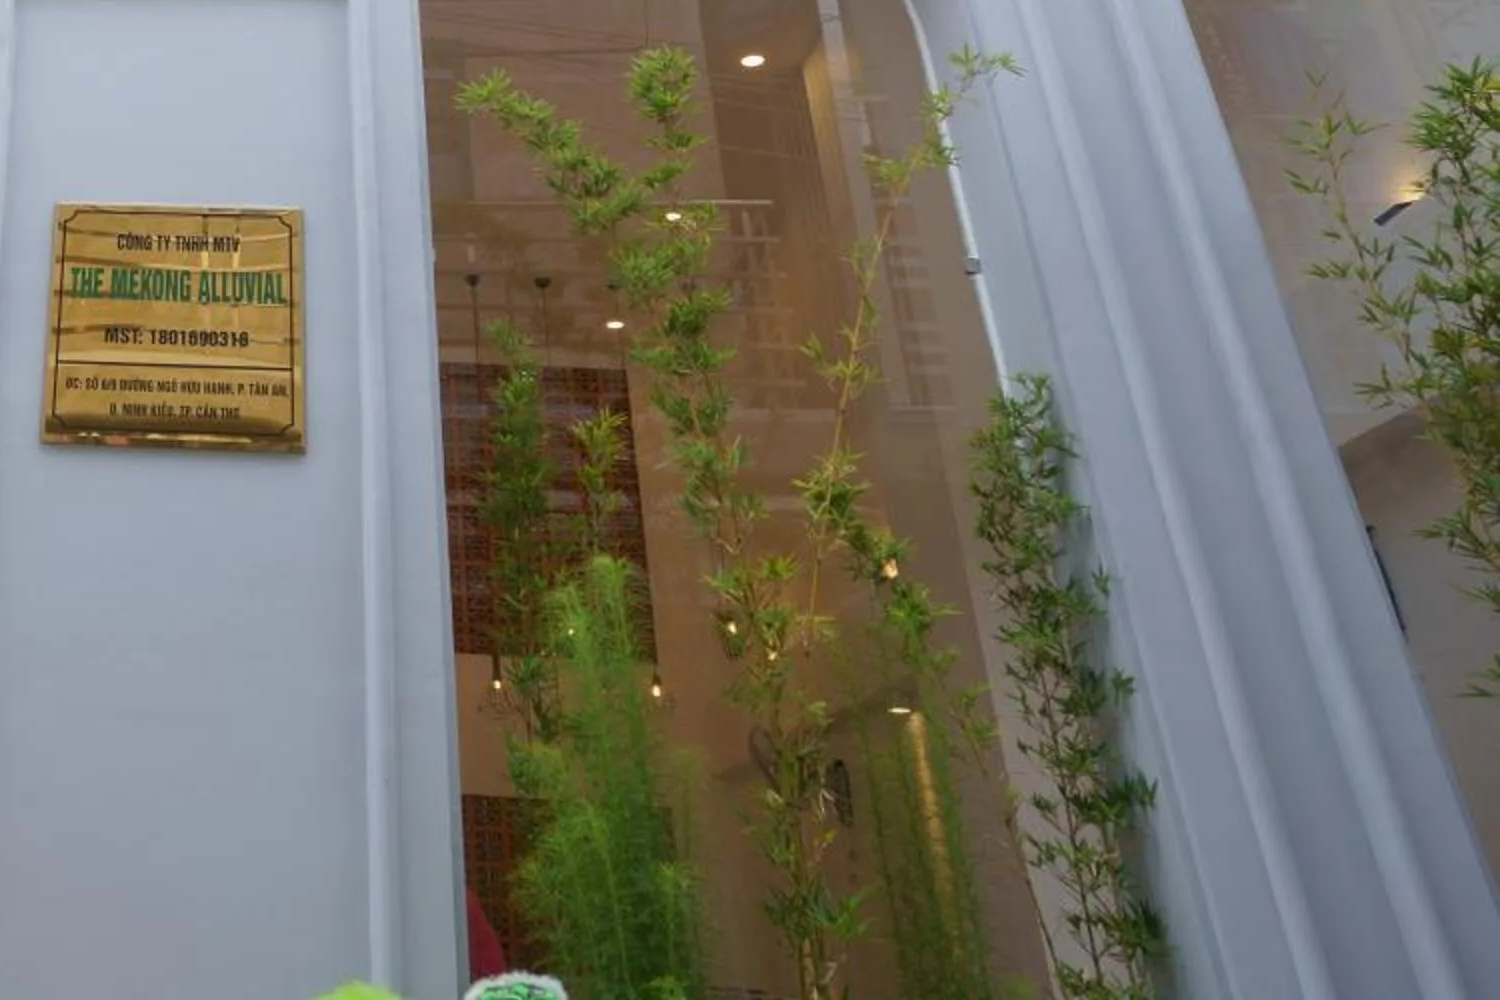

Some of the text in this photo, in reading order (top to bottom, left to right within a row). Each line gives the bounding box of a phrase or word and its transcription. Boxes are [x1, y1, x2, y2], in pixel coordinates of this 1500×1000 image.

[156, 234, 171, 251] TY
[213, 236, 241, 252] MTV
[70, 267, 289, 304] THE MEKONG ALLUVIAL
[104, 327, 144, 345] MST:
